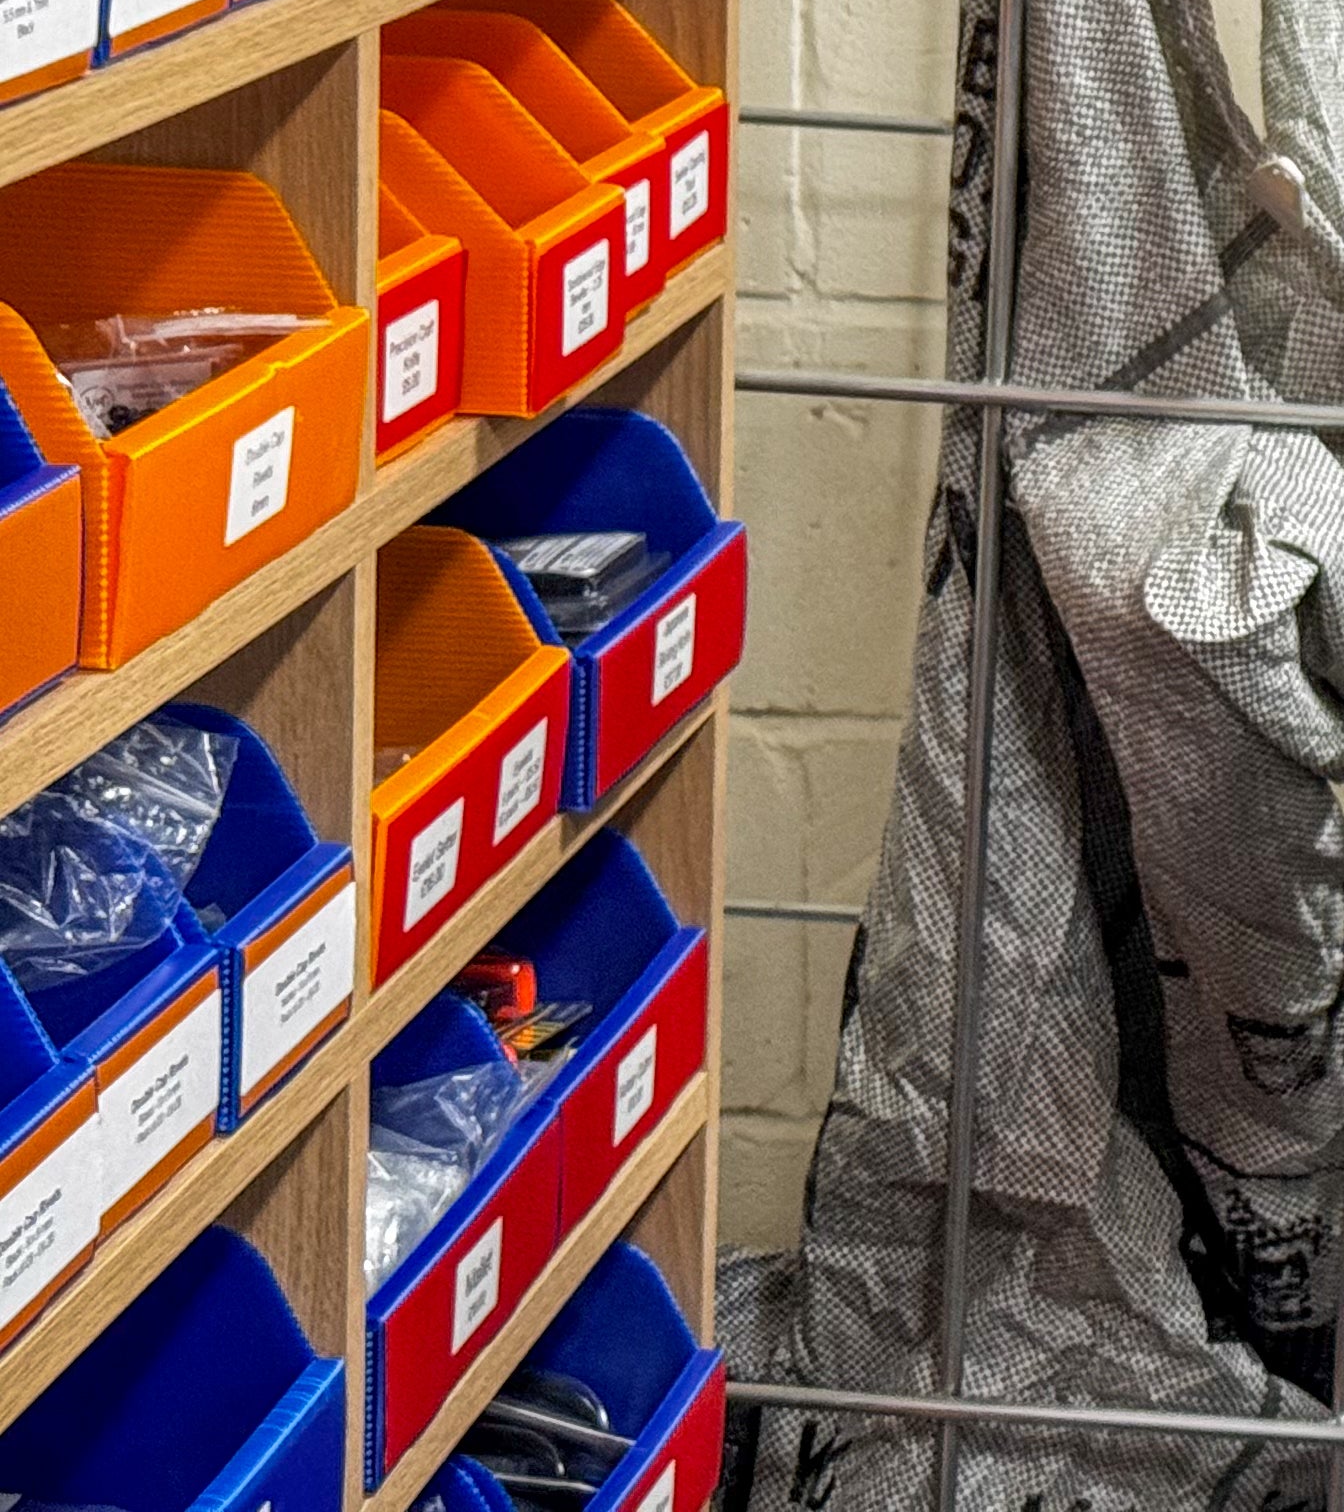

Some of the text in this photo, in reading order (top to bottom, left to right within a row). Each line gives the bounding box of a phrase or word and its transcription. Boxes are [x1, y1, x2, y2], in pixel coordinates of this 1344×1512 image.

[156, 1071, 168, 1089] Cap
[24, 1212, 39, 1233] Cap
[40, 1187, 62, 1215] Rivets
